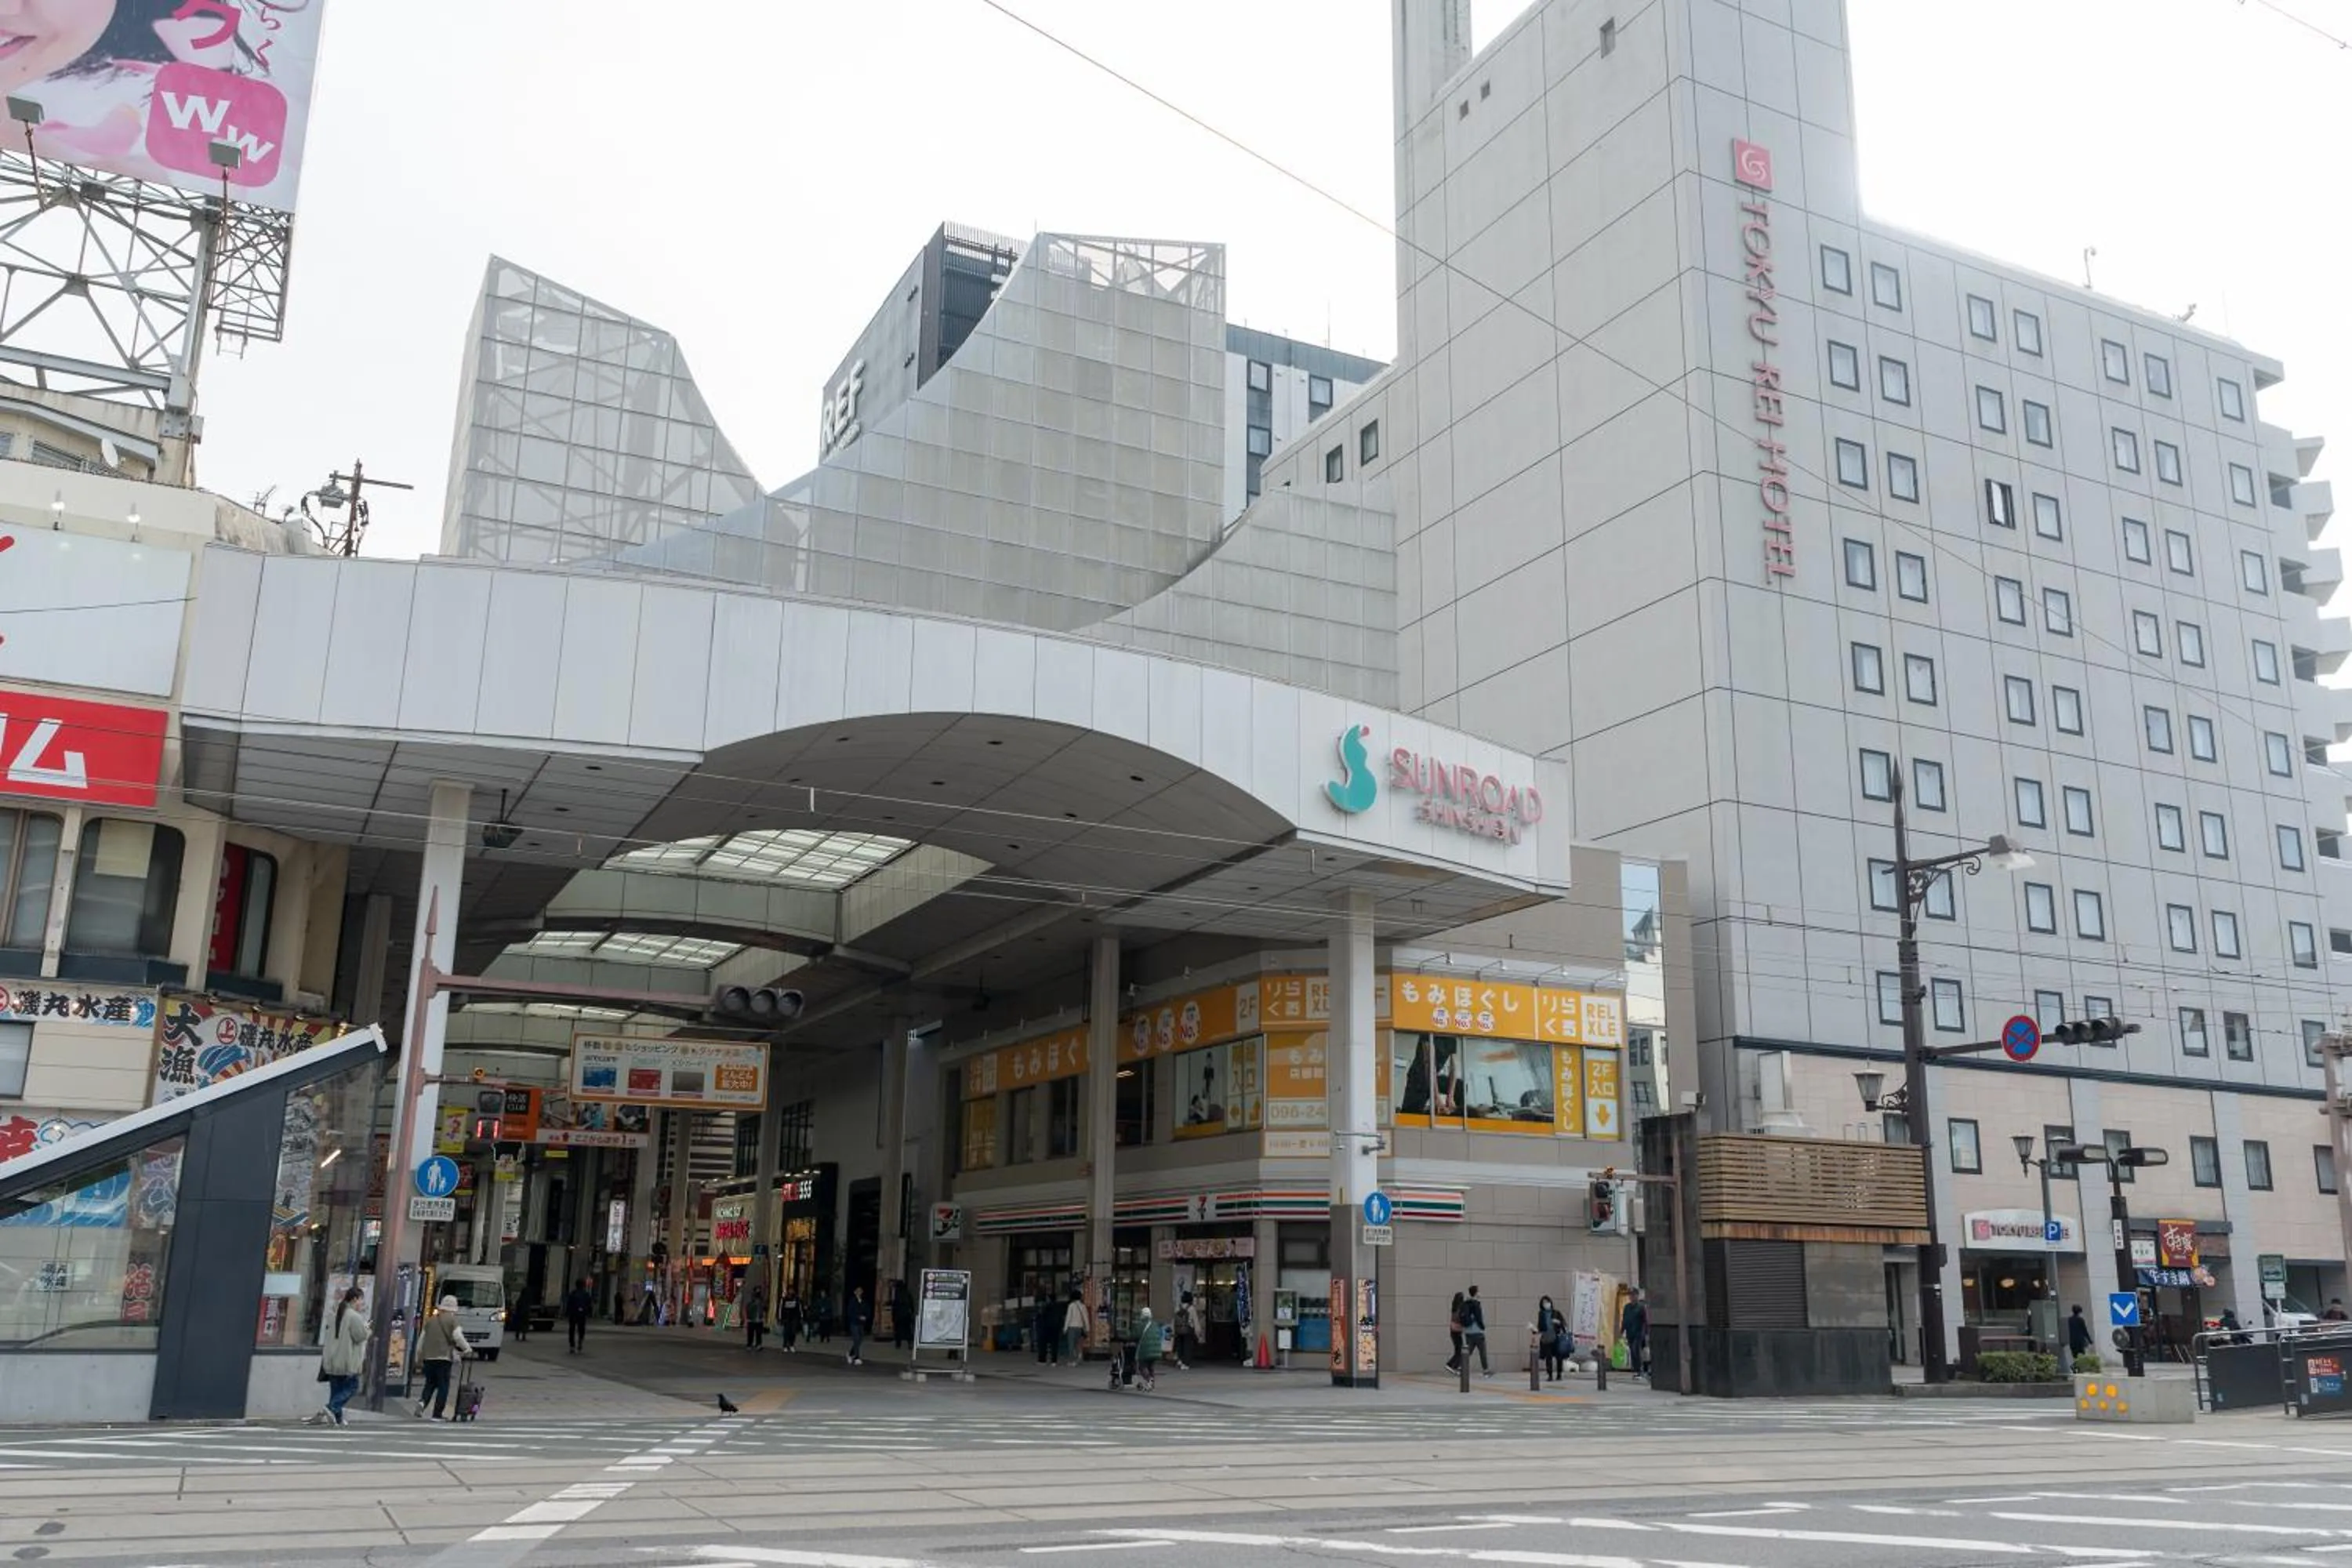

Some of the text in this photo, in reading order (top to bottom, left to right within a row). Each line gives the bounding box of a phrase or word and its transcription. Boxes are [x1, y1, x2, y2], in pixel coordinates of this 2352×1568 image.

[821, 358, 864, 454] REF
[1741, 201, 1795, 585] TOKYU REI HOTEL
[1390, 747, 1543, 825] SUNROAD
[1401, 981, 1519, 1012] もみほぐし
[1013, 1037, 1091, 1080] もみほぐ
[1561, 1051, 1574, 1131] もみほぐし
